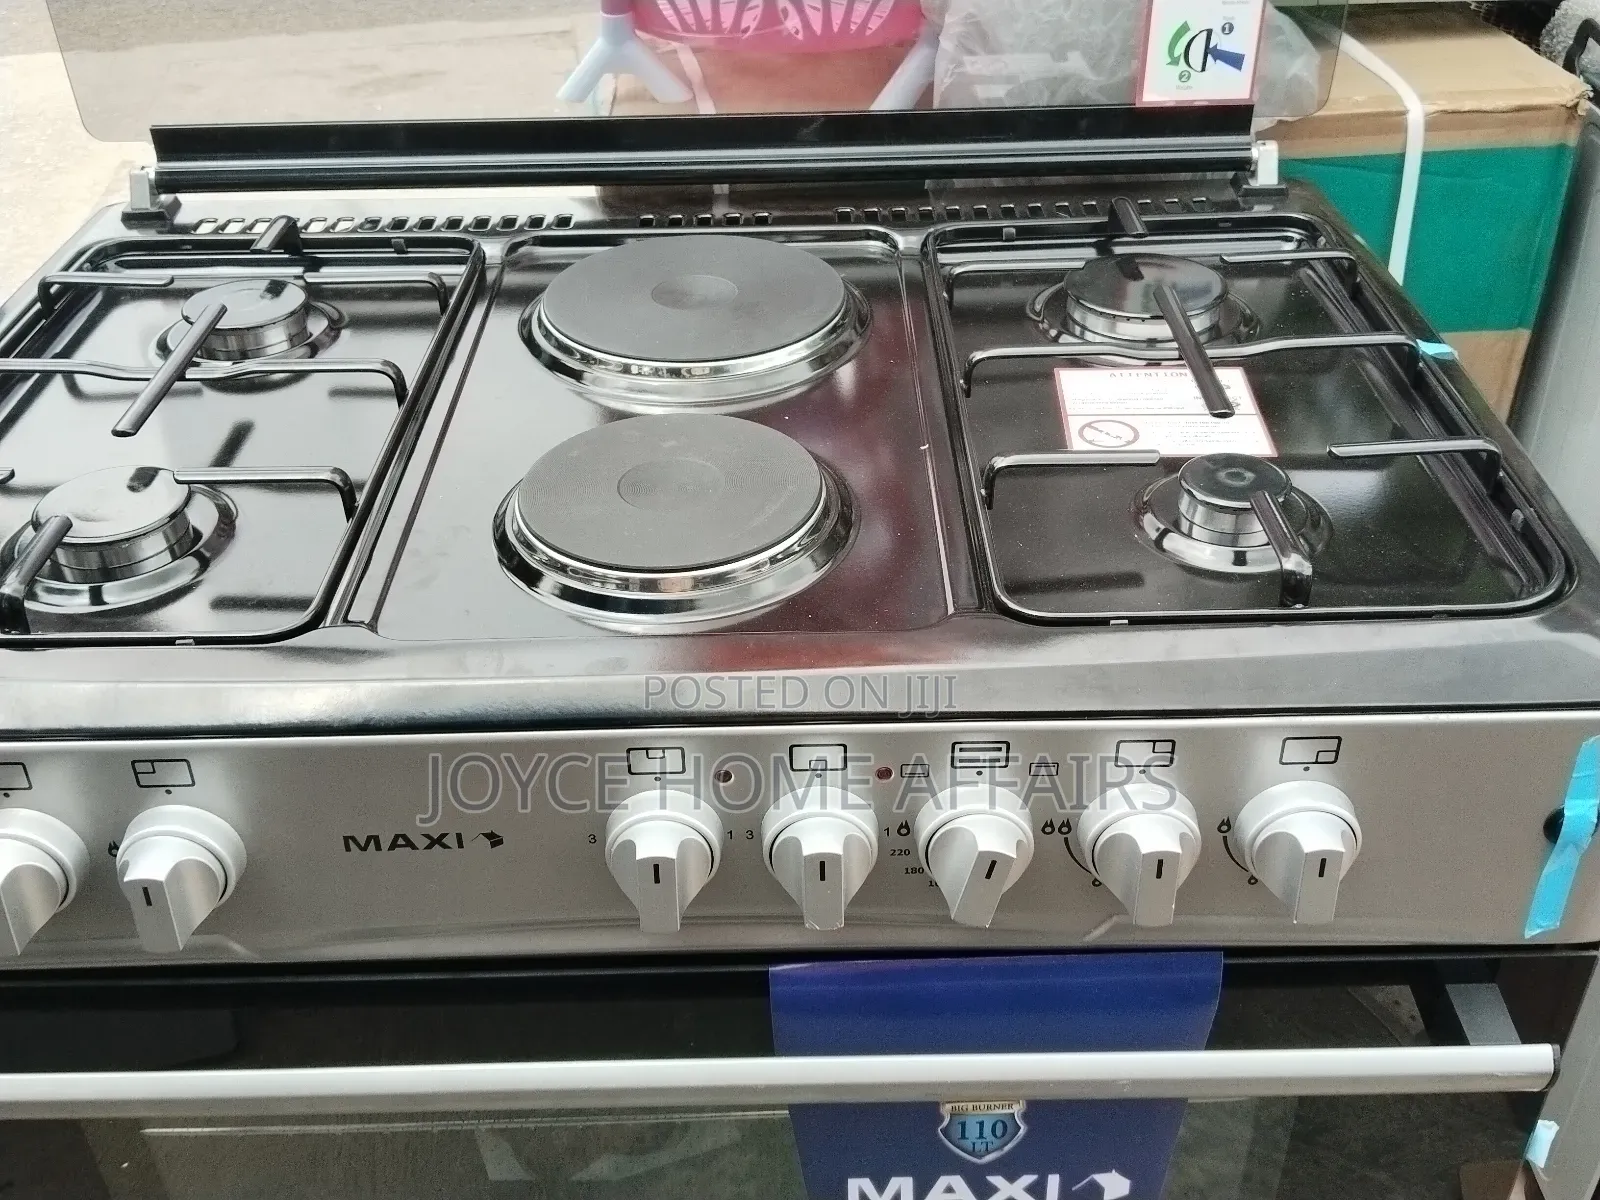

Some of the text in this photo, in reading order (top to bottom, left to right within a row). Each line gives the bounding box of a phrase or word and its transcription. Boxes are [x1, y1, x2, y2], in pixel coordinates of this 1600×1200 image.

[726, 830, 733, 840] 1
[745, 830, 754, 840] 3
[883, 827, 890, 837] 1
[342, 832, 464, 851] MAXI
[588, 834, 597, 844] 3
[889, 848, 911, 857] 220
[904, 867, 925, 875] 180
[950, 1103, 1014, 1113] BIG BURNER
[957, 1119, 1009, 1141] 110
[971, 1141, 994, 1154] LT
[847, 1173, 1060, 1200] MAXI
